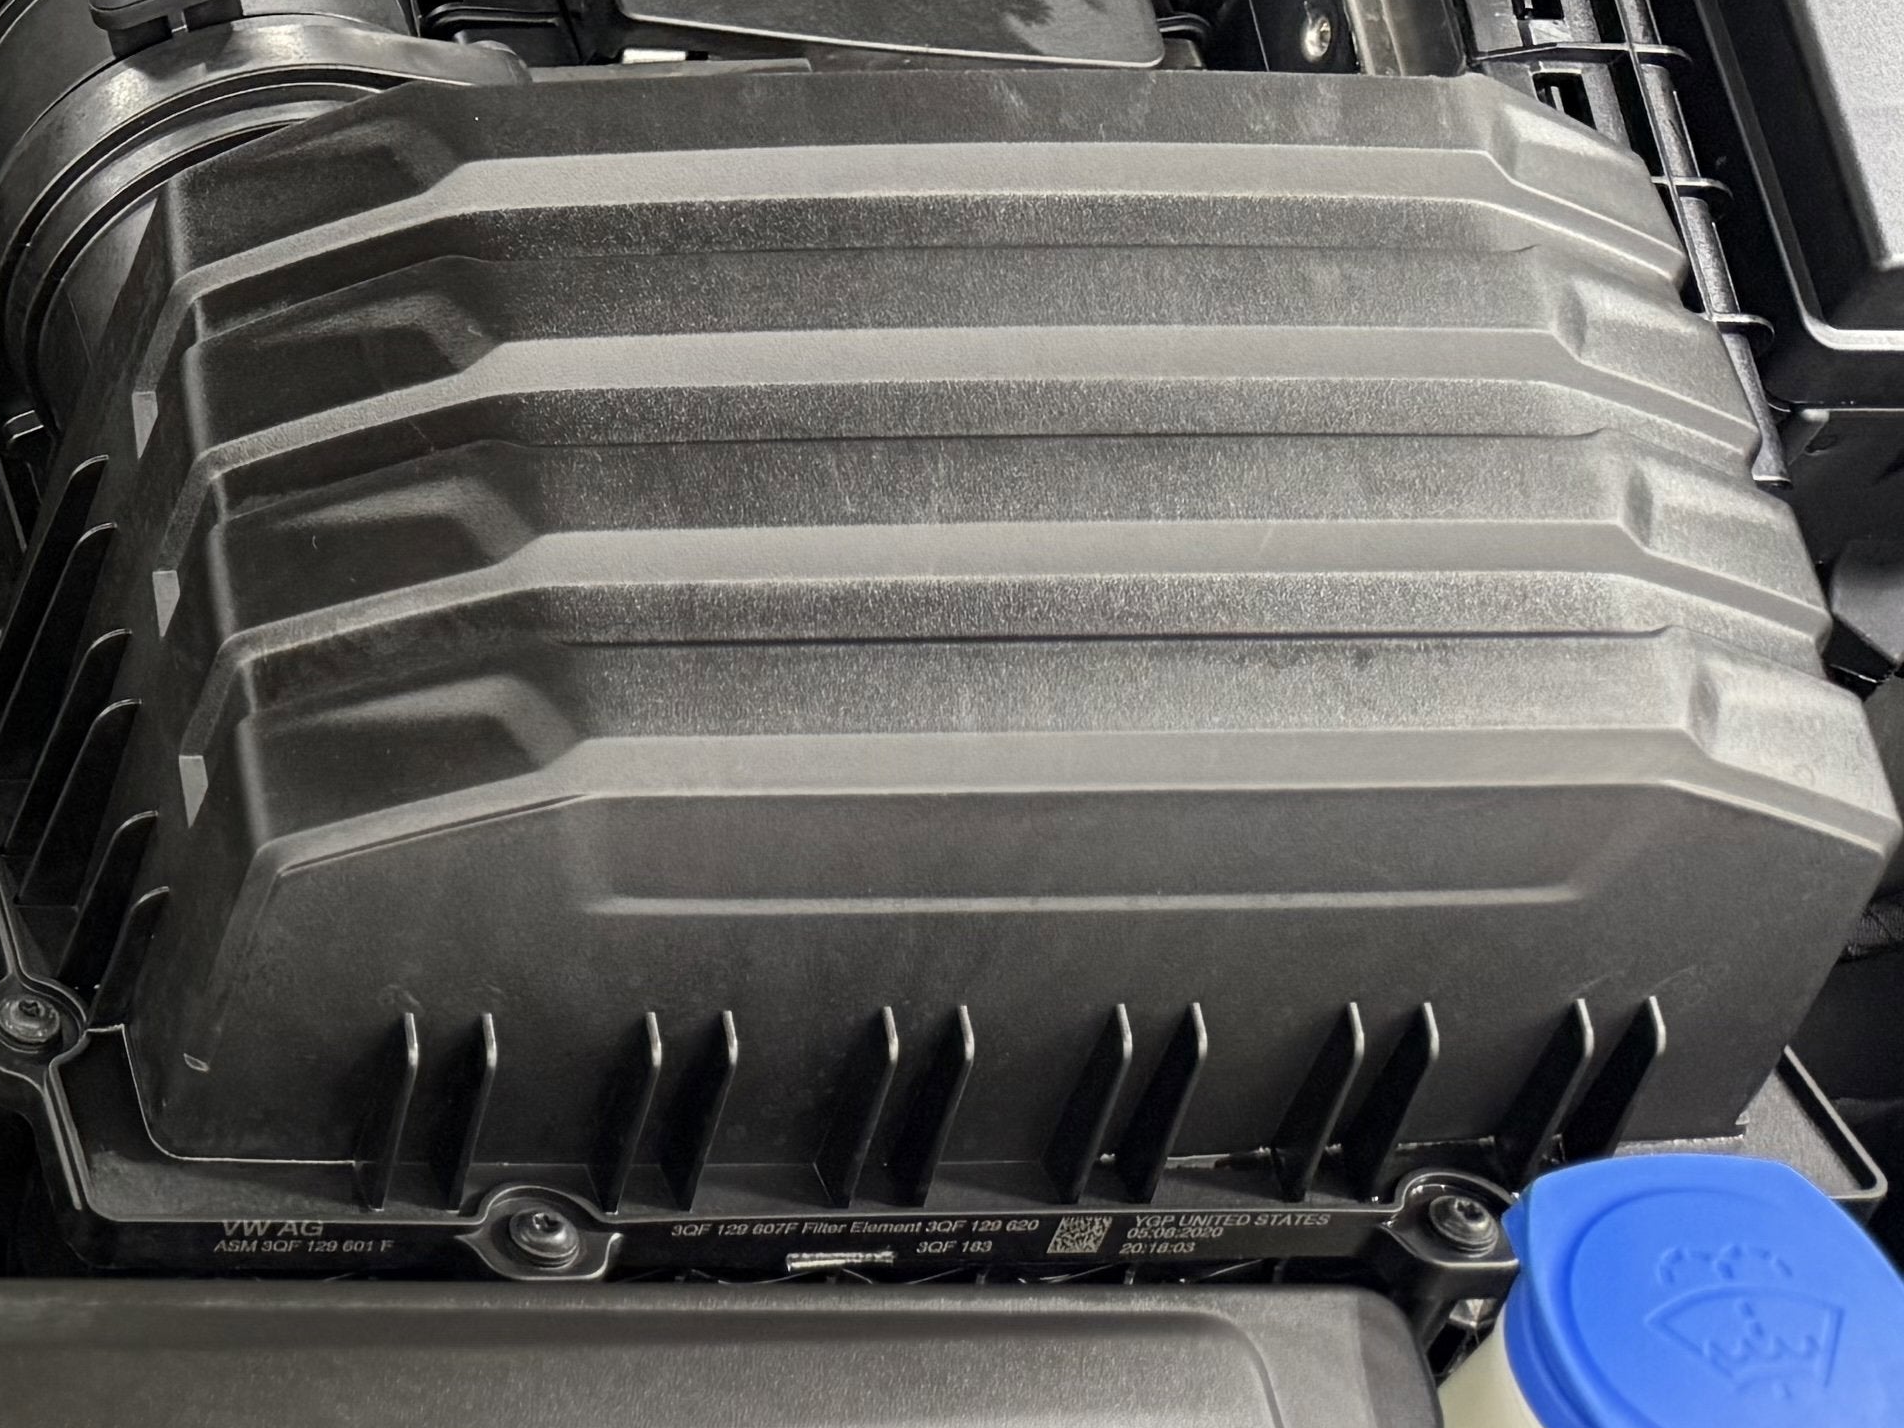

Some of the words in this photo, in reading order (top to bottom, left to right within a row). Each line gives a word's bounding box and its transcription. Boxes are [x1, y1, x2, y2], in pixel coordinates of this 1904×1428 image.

[1179, 1214, 1250, 1227] UNITED
[1254, 1213, 1331, 1226] STATES
[221, 1219, 271, 1237] VW
[277, 1219, 324, 1237] AG
[801, 1221, 847, 1235] Filter
[850, 1220, 922, 1234] Element
[213, 1239, 257, 1253] ASM
[307, 1239, 336, 1253] 129
